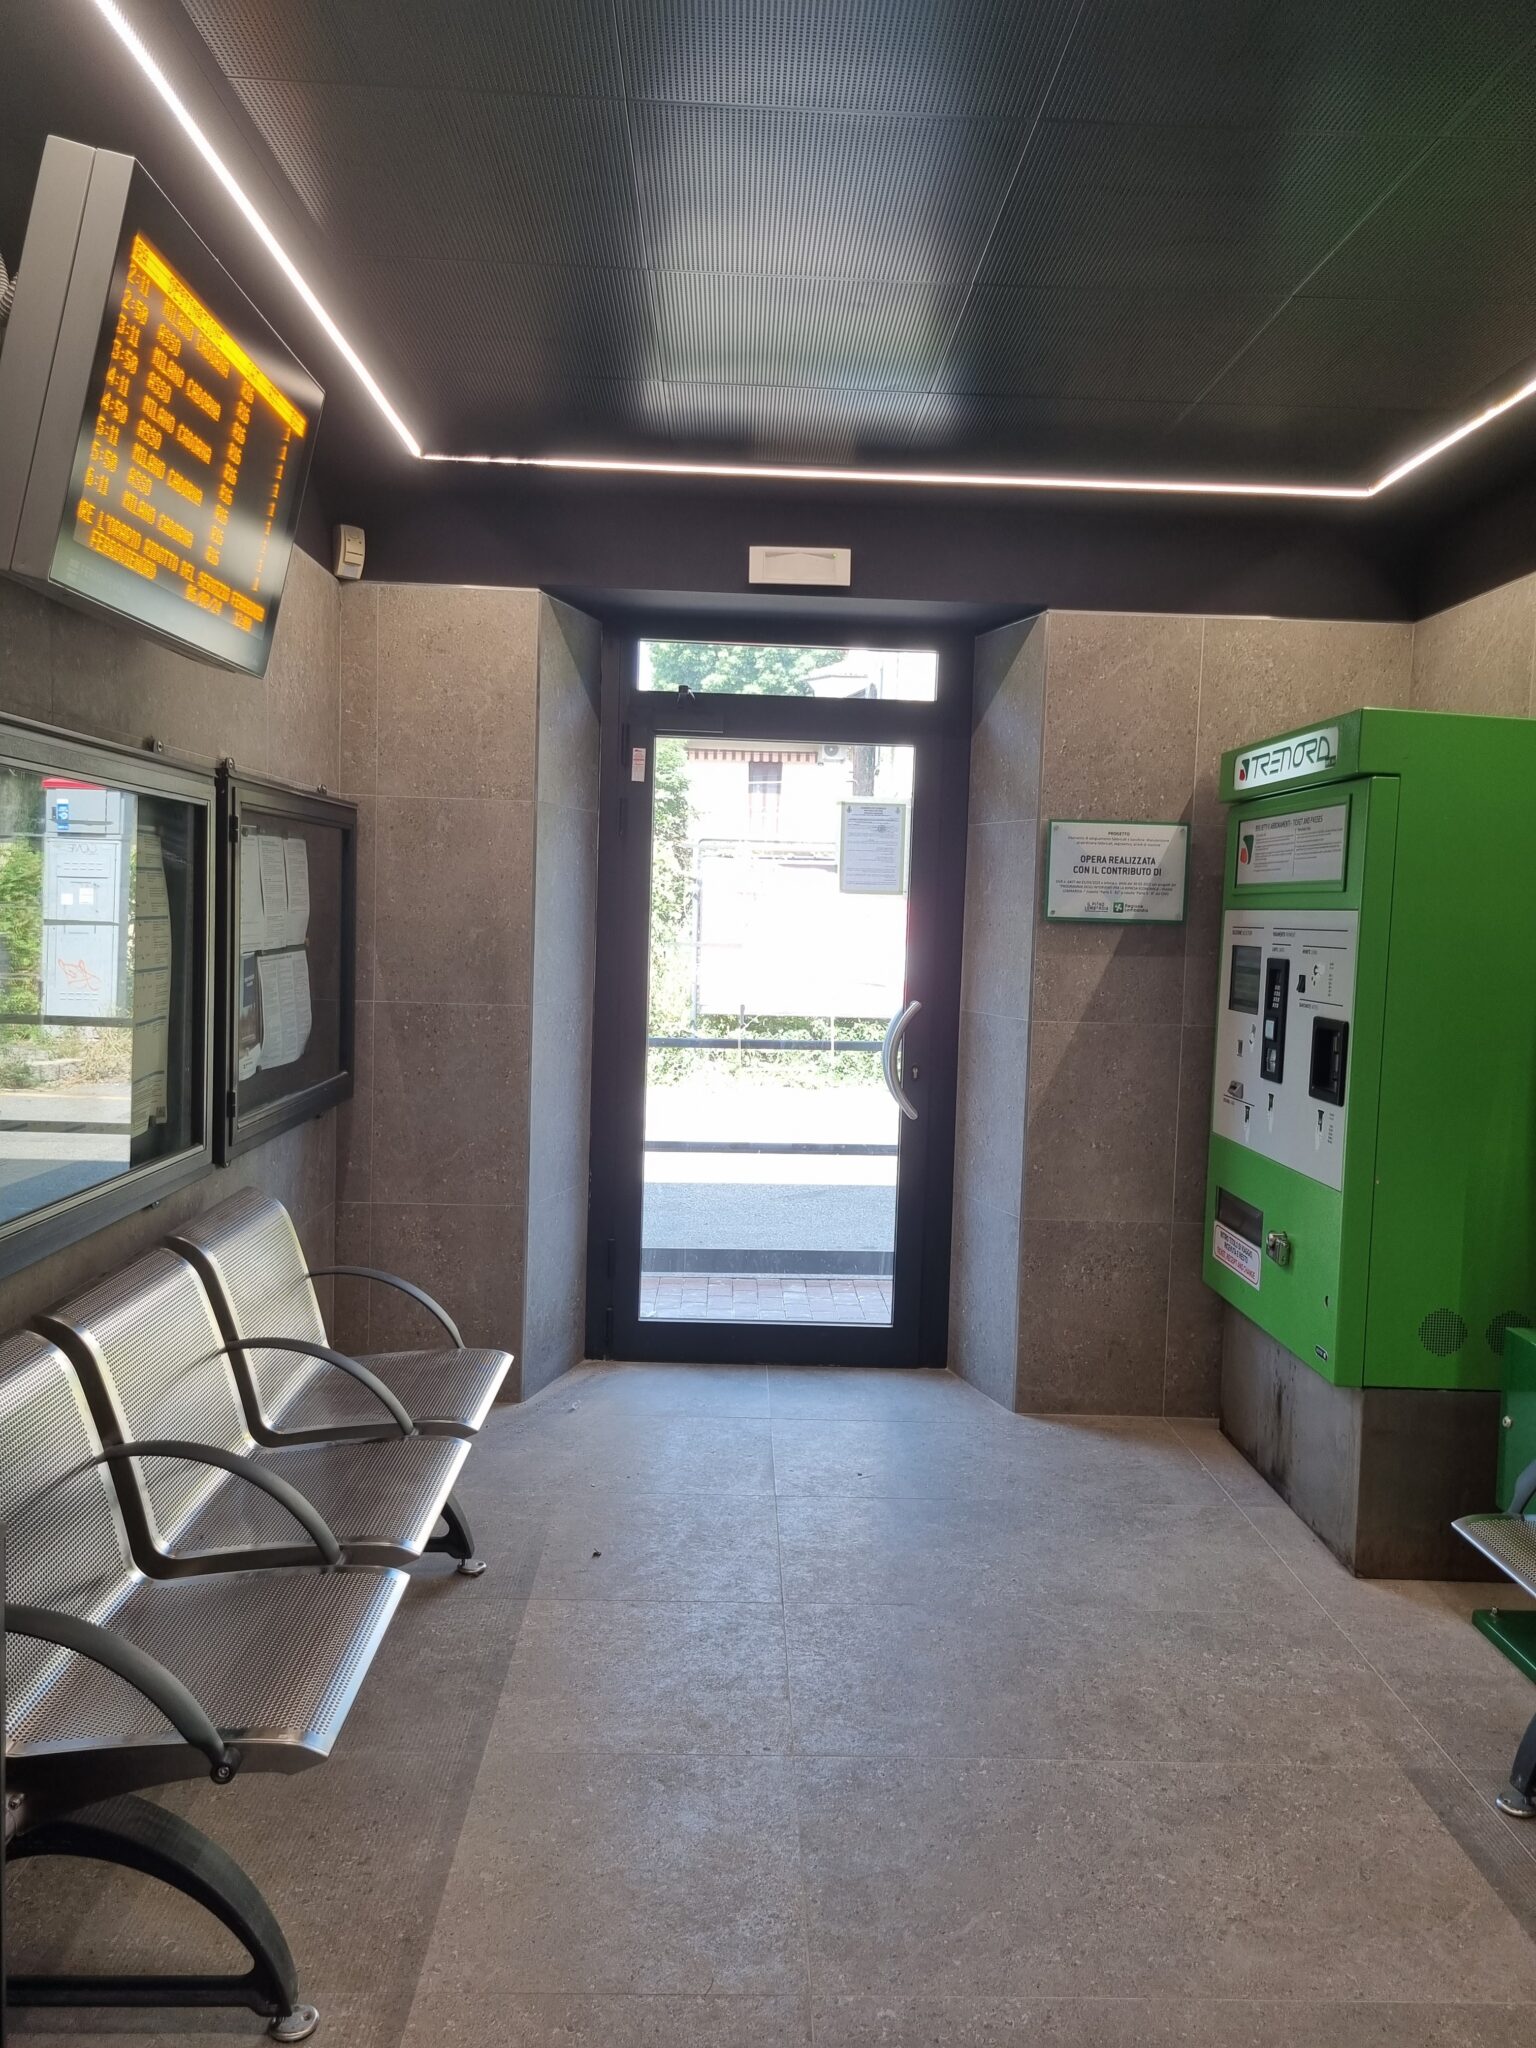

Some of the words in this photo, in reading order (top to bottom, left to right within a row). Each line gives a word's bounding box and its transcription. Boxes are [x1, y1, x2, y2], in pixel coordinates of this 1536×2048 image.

[162, 298, 193, 342] MILANO
[157, 322, 181, 358] ASSO
[151, 345, 184, 389] MILANO
[147, 370, 172, 404] ASSO
[142, 394, 175, 434] MILANO
[137, 419, 162, 451] ASSO
[131, 443, 165, 481] MILANO
[127, 467, 153, 496] ASSO
[122, 491, 156, 525] MILANO
[180, 561, 195, 582] DEL
[1252, 735, 1330, 779] TRENORD
[1080, 855, 1107, 864] OPERA
[1109, 855, 1156, 865] REALIZZATA
[1092, 867, 1099, 875] IL
[1101, 868, 1151, 876] CONTRIBUTO
[1153, 869, 1162, 877] DI
